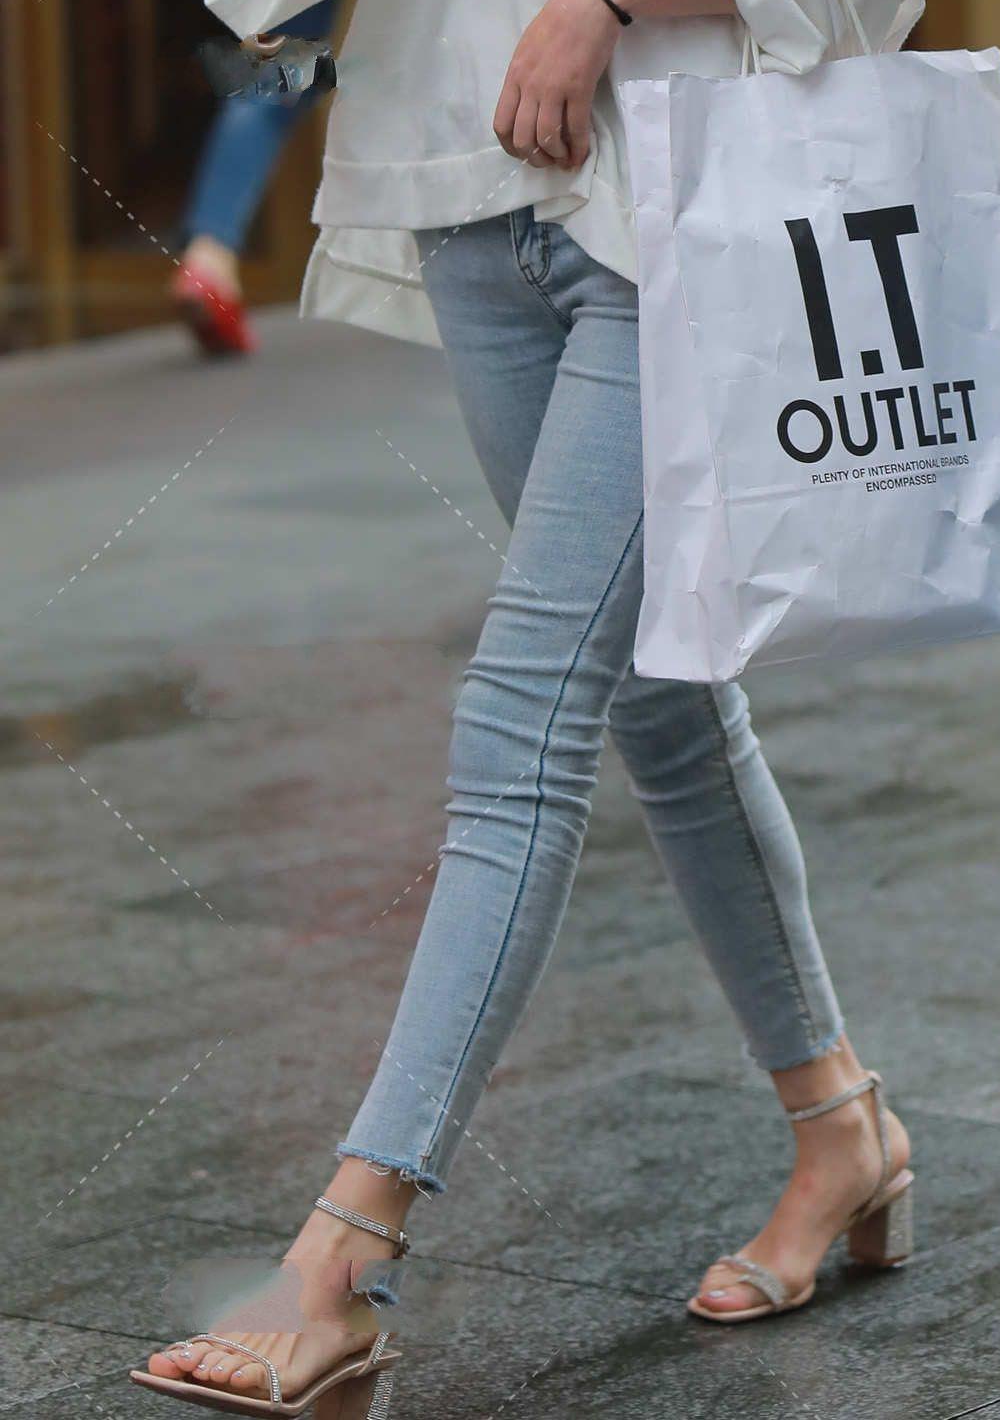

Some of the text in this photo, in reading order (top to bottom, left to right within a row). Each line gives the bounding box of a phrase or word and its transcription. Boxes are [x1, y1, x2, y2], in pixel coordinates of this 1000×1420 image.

[784, 204, 924, 381] I.T
[777, 380, 977, 464] OUTLET
[812, 454, 970, 485] PLENTY OF INTERNATIONAL BRANDS
[866, 473, 937, 492] ENCOMPASSED
